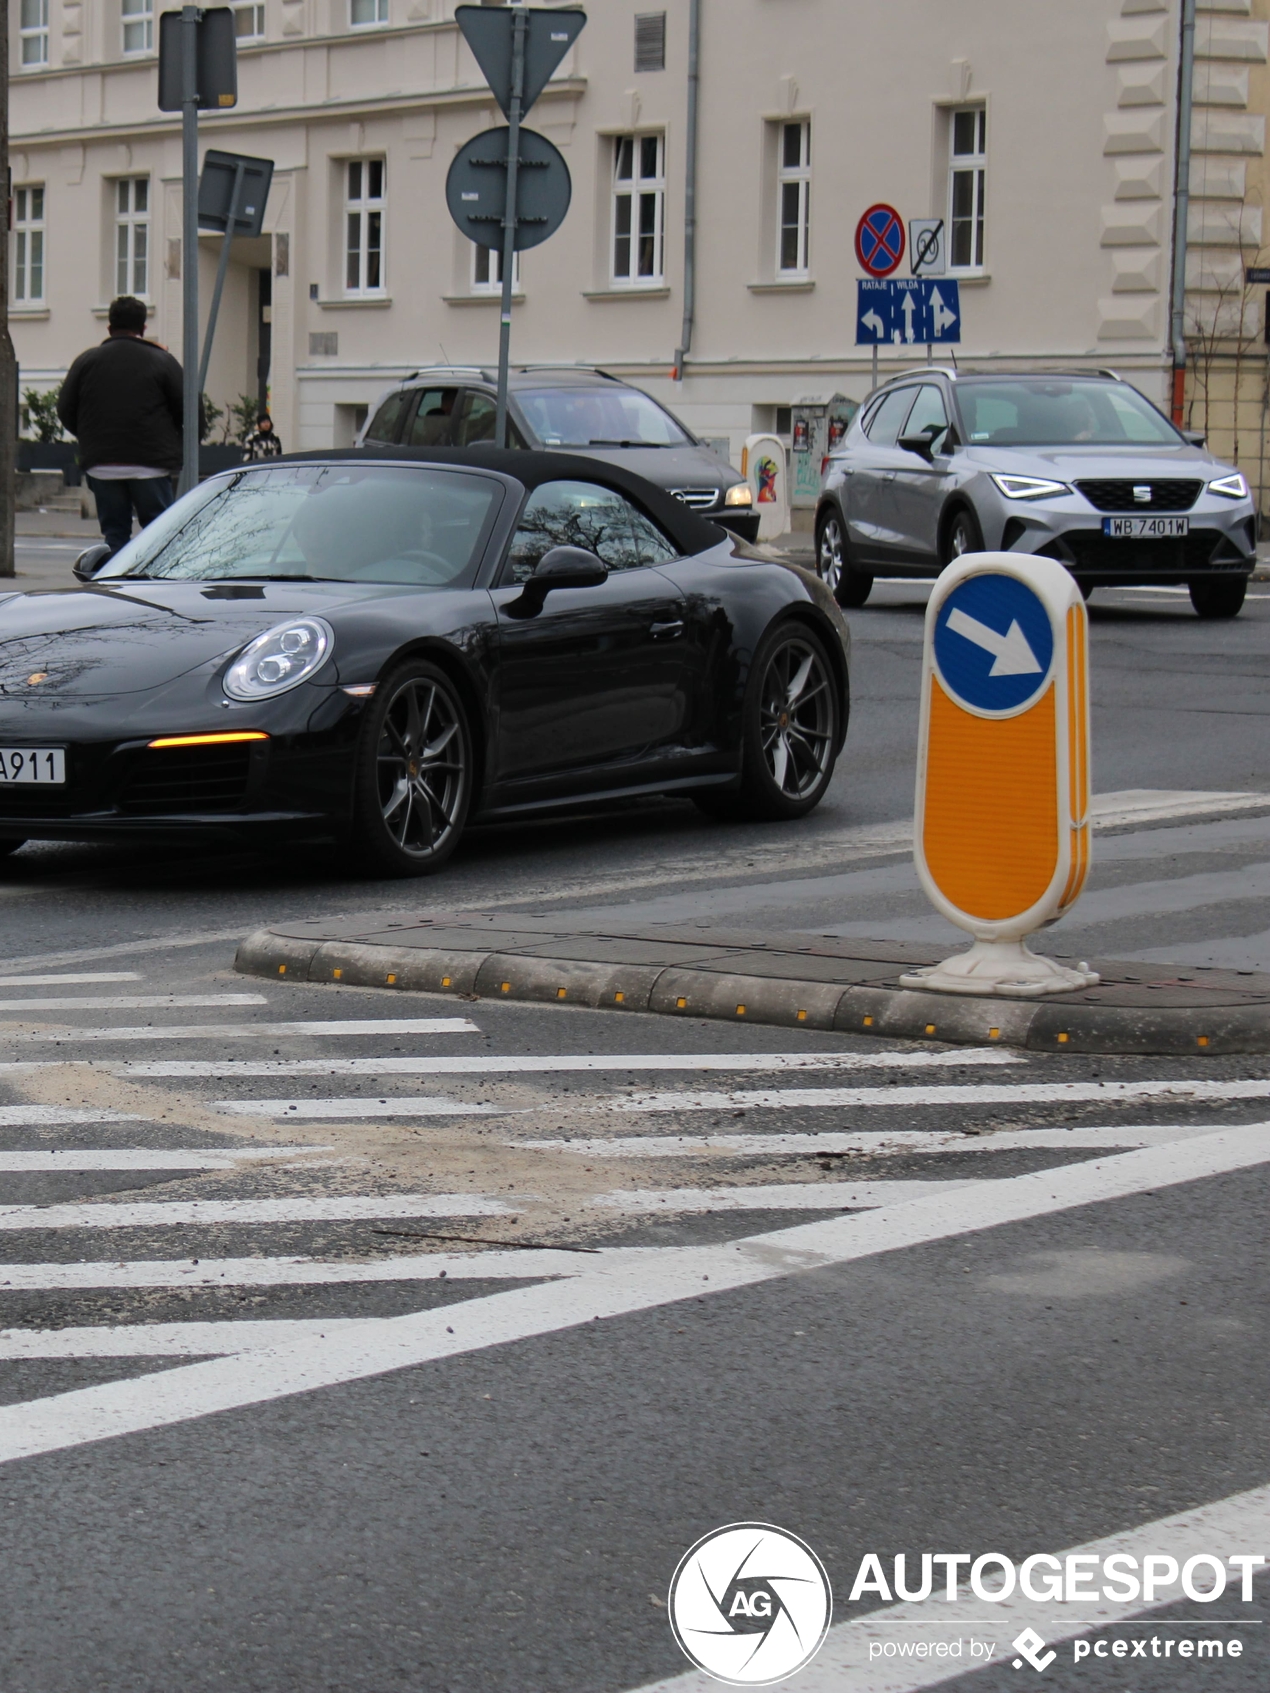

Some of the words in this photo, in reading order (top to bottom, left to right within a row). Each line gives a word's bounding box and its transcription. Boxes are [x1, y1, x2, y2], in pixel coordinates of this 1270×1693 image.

[862, 281, 887, 290] RATAJE
[896, 280, 918, 290] WILDA
[1113, 519, 1132, 535] WB
[1138, 519, 1185, 535] 7401W
